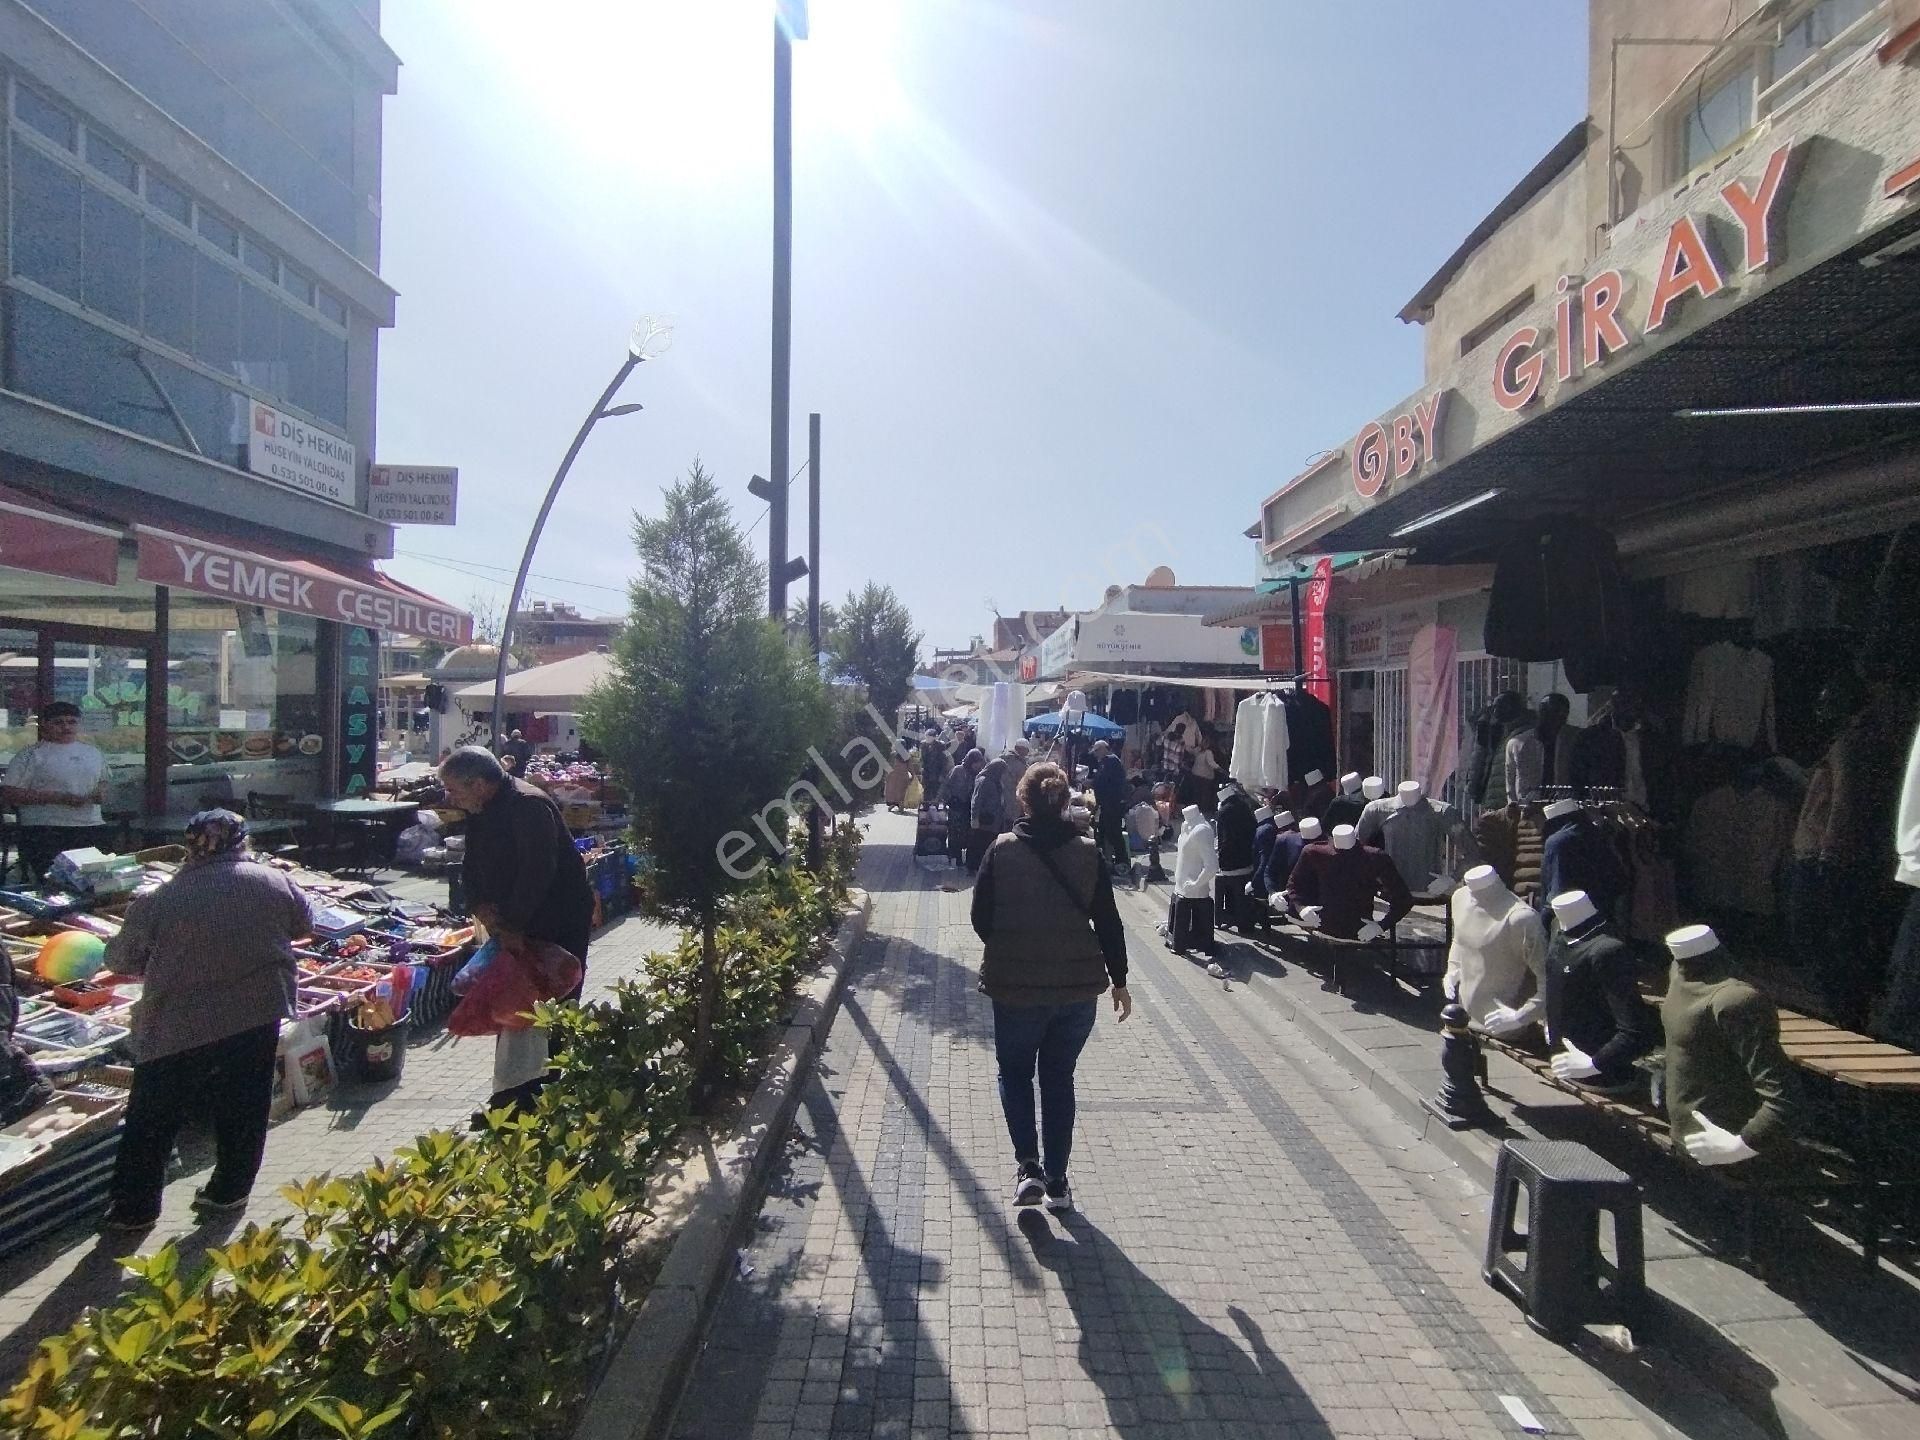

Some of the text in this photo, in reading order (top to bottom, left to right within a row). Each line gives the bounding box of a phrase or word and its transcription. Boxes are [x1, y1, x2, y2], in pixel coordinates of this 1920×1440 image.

[1393, 388, 1442, 480] BY
[1492, 134, 1796, 412] GİRAY
[281, 420, 353, 465] DİŞ HEKİMİ
[299, 472, 315, 488] 501
[316, 480, 327, 494] 00
[174, 544, 462, 641] YEMEK ÇEŞİTLERİ
[344, 627, 372, 794] AKASYA
